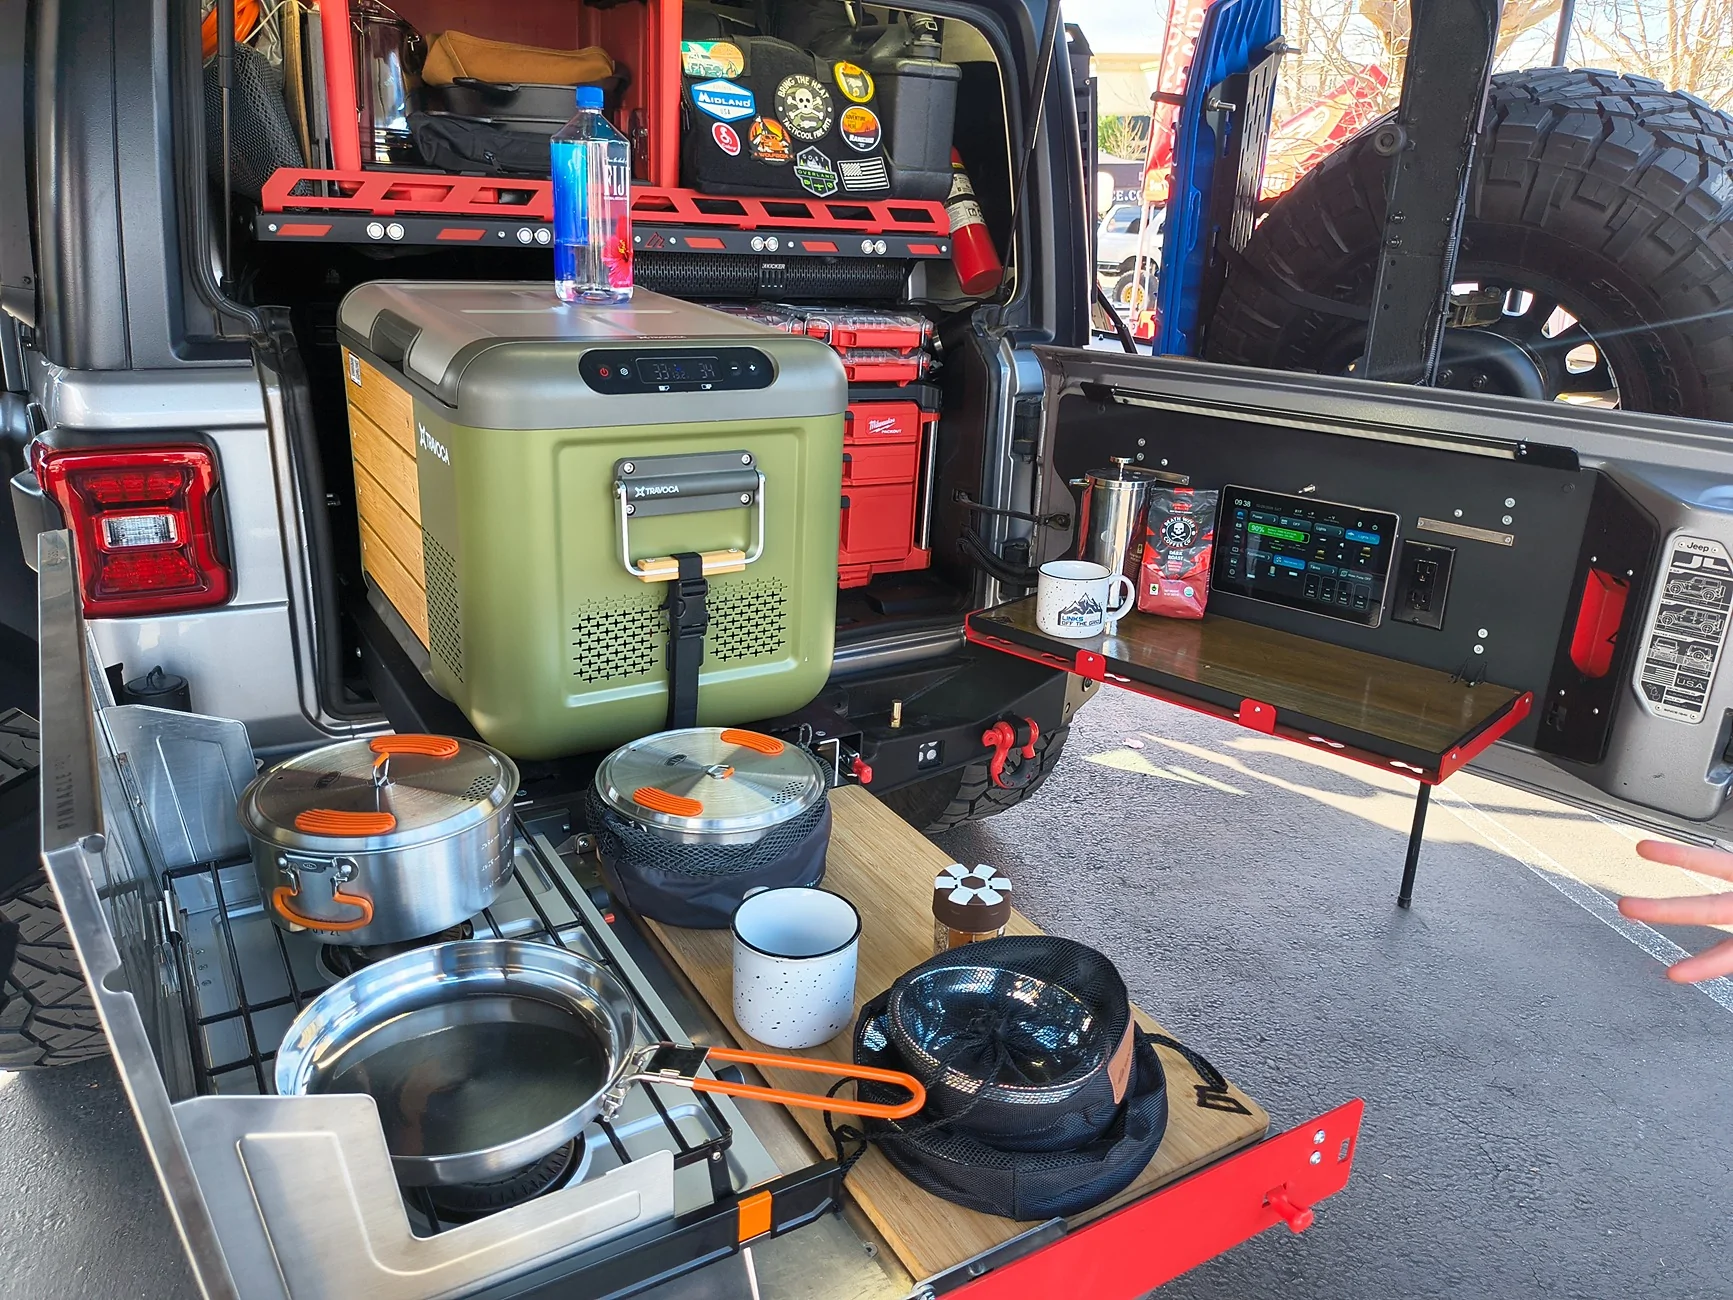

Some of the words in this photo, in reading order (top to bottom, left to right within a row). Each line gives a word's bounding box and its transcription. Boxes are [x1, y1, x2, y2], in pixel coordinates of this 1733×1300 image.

[777, 77, 795, 98] BRING
[795, 75, 810, 85] THE
[811, 80, 829, 99] HEAT
[698, 92, 751, 107] MIDLAND
[782, 117, 813, 139] TACTICOOL
[797, 169, 834, 179] OVERLAND
[645, 485, 679, 496] TRAVOCA
[1163, 516, 1181, 527] DEATH
[1251, 524, 1265, 533] 90%
[1686, 541, 1709, 553] Jeep
[55, 771, 75, 830] PINNACLE
